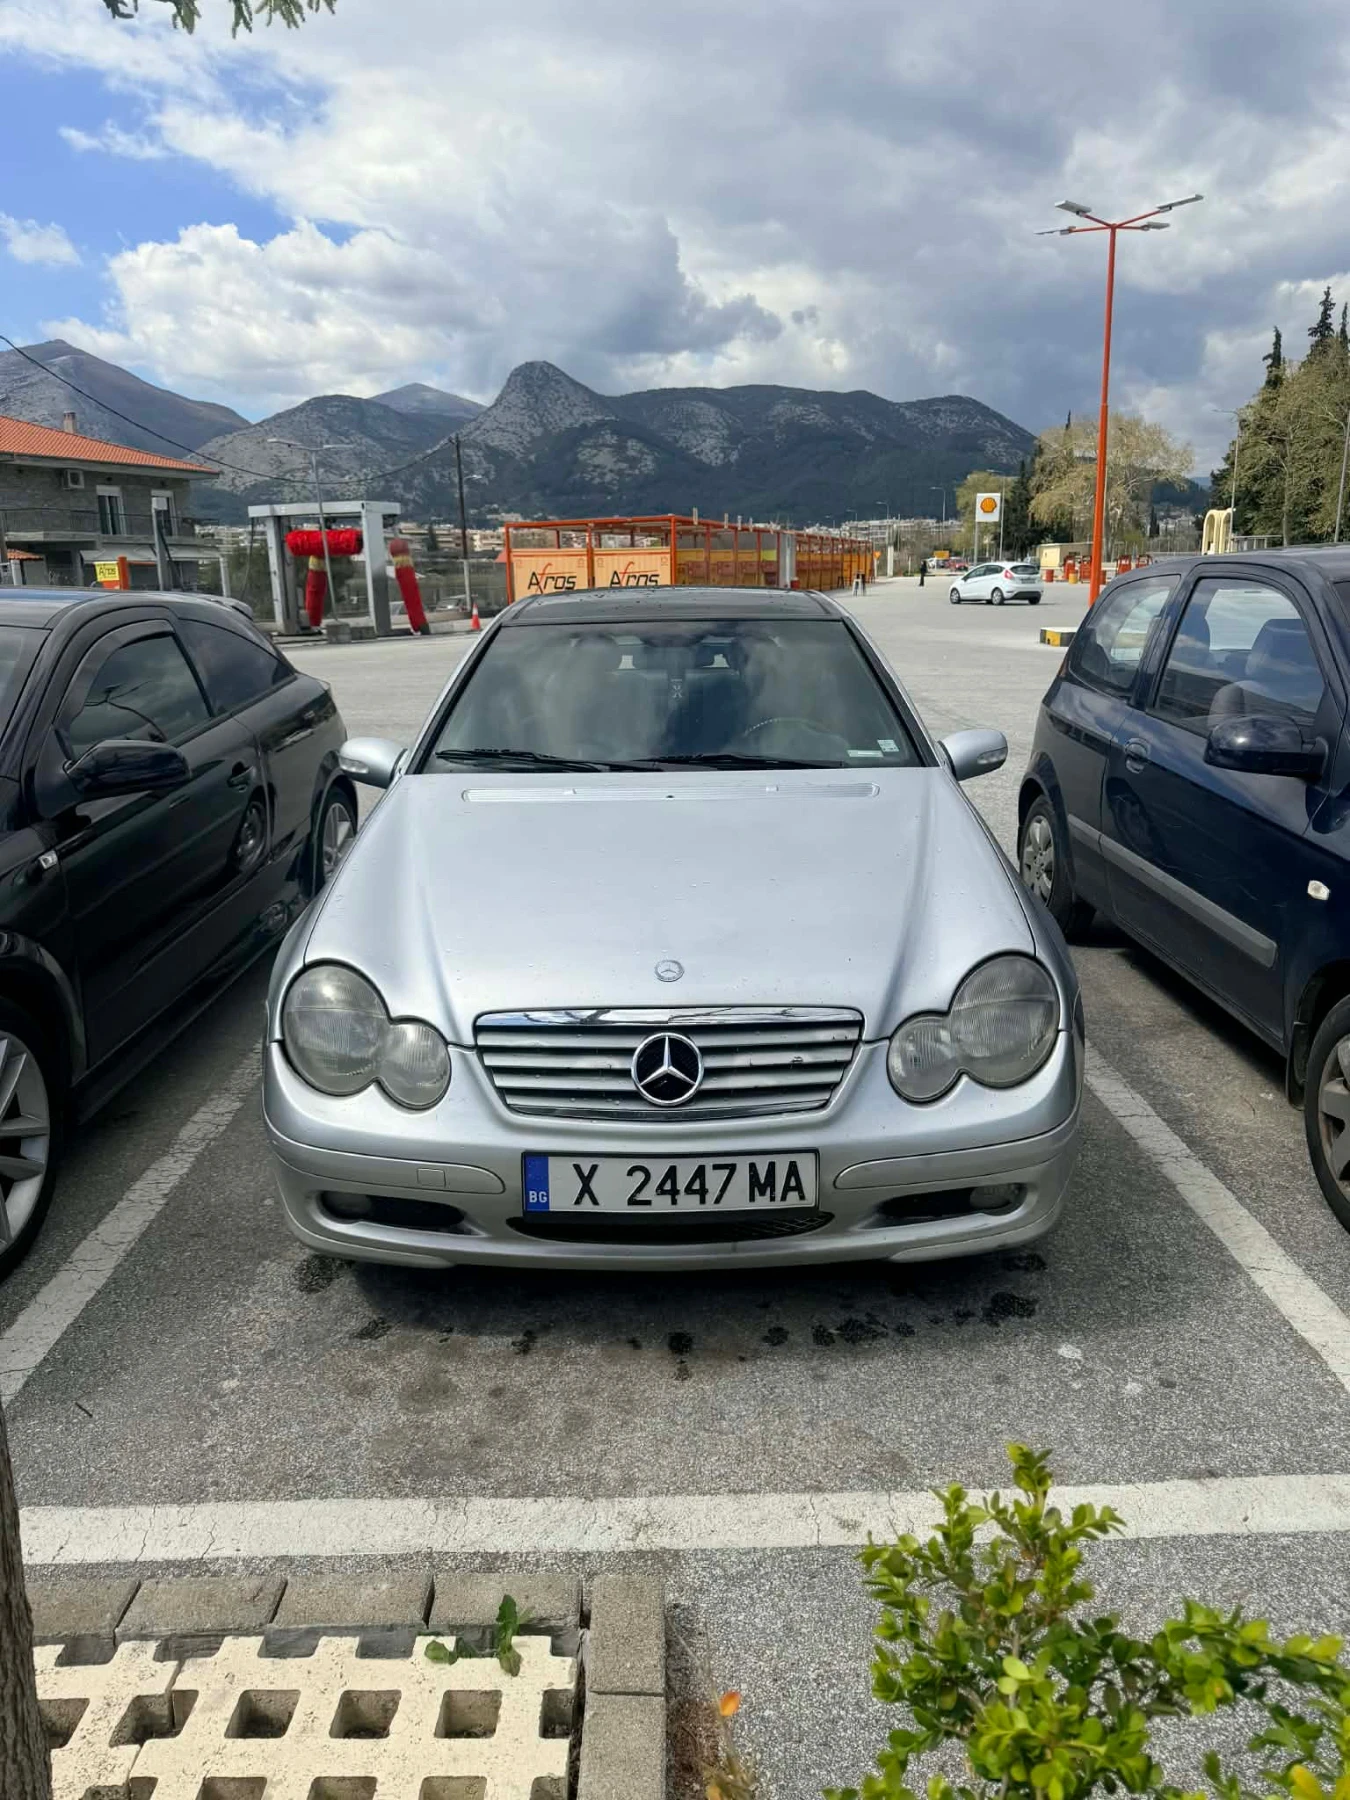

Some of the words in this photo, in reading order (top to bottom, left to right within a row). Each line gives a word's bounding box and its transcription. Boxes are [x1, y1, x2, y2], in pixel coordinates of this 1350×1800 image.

[528, 562, 577, 594] Afros
[529, 1190, 548, 1203] BG
[572, 1163, 600, 1206] X
[626, 1163, 737, 1206] 2447
[748, 1161, 806, 1203] MA
